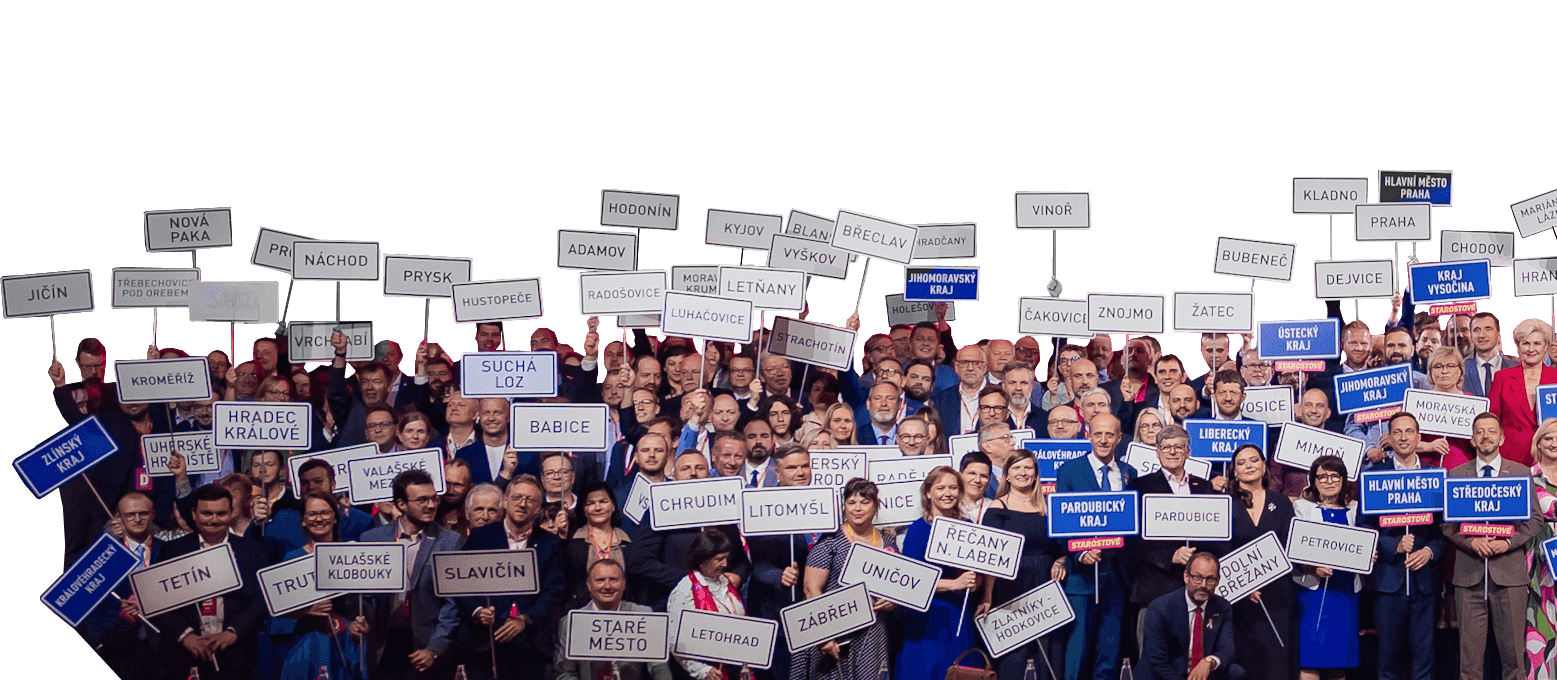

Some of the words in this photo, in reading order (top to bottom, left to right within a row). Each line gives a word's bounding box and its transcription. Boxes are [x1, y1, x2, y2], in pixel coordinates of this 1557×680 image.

[1385, 175, 1415, 188] HLAVNÍ
[1418, 176, 1447, 188] MĚSTO
[1304, 190, 1358, 201] KLADNO
[1401, 189, 1430, 199] PRAHA
[609, 202, 671, 218] HODONÍN
[1032, 202, 1072, 216] VINOŘ
[170, 212, 210, 228] NOVÁ
[1371, 216, 1416, 228] PRAHA
[171, 231, 210, 243] PAKA
[724, 223, 764, 237] KYJOV
[843, 225, 907, 249] BŘECLAV
[568, 244, 626, 258] ADAMOV
[1451, 242, 1504, 254] CHODOV
[305, 252, 368, 266] NÁCHOD
[784, 247, 836, 265] VYŠKOV
[1222, 250, 1289, 267] BUBENEČ
[404, 270, 452, 283] PRYSK
[909, 272, 975, 284] JIHOMORAVSKÝ
[1326, 273, 1383, 285] DEJVICE
[1438, 270, 1462, 282] KRAJ
[28, 284, 68, 301] JIČÍN
[123, 289, 144, 297] POD
[146, 289, 188, 297] OREBEM
[588, 287, 660, 300] RADOŠOVICE
[727, 279, 796, 295] LETŇANY
[1428, 281, 1474, 295] VYSOČINA
[463, 292, 532, 307] HUSTOPEČE
[671, 306, 745, 325] LUHAČOVICE
[1098, 307, 1153, 320] ZNOJMO
[1192, 303, 1234, 317] ŽATEC
[1430, 303, 1475, 314] STAROSTOVÉ
[1278, 326, 1318, 338] ÚSTECKÝ
[777, 332, 846, 354] STRACHOTÍN
[1286, 339, 1310, 351] KRAJ
[482, 357, 537, 372] SUCHÁ
[132, 371, 194, 386] KROMĚŘÍŽ
[496, 376, 523, 388] LOZ
[1340, 372, 1408, 393] JIHOMORAVSKÝ
[1416, 400, 1475, 416] MORAVSKÁ
[229, 411, 296, 423] HRADEC
[1418, 411, 1447, 424] NOVÁ
[1452, 414, 1471, 427] VES
[225, 425, 299, 440] KRÁLOVÉ
[530, 421, 590, 433] BABICE
[1199, 427, 1250, 441] LIBERECKÝ
[41, 433, 83, 467] ZLÍNSKÝ
[56, 451, 86, 474] KRAJ
[1368, 479, 1408, 491] HLAVNÍ
[1409, 478, 1440, 490] MĚSTO
[1453, 485, 1522, 499] STŘEDOČESKÝ
[660, 493, 736, 512] CHRUDIM
[1387, 492, 1421, 504] PRAHA
[749, 501, 828, 518] LITOMYŠL
[1061, 499, 1126, 514] PARDUBICKÝ
[1474, 500, 1500, 512] KRAJ
[1080, 515, 1107, 527] KRAJ
[1154, 511, 1220, 522] PARDUBICE
[1382, 515, 1431, 524] STAROSTOVÉ
[947, 522, 1009, 551] ŘEČANY
[1463, 525, 1512, 535] STAROSTOVÉ
[1071, 538, 1121, 549] STAROSTOVÉ
[1301, 536, 1363, 554] PETROVICE
[329, 550, 390, 566] VALAŠSKÉ
[936, 542, 952, 557] N.
[957, 545, 1010, 569] LABEM
[1221, 545, 1264, 575] DOLNÍ
[54, 543, 118, 608] KRÁLOVÉHRADECKÝ
[328, 568, 392, 580] KLOBOUKY
[445, 562, 526, 580] SLAVIČÍN
[862, 560, 920, 589] UNIČOV
[1220, 557, 1280, 597] BŘEŽANY
[159, 566, 211, 593] TETÍN
[798, 600, 858, 632] ZÁBŘEH
[992, 600, 1043, 630] ZLATNÍKY
[591, 617, 646, 633] STARÉ
[996, 605, 1060, 641] HODKOVICE
[589, 632, 647, 651] MĚSTO
[691, 627, 759, 648] LETOHRAD
